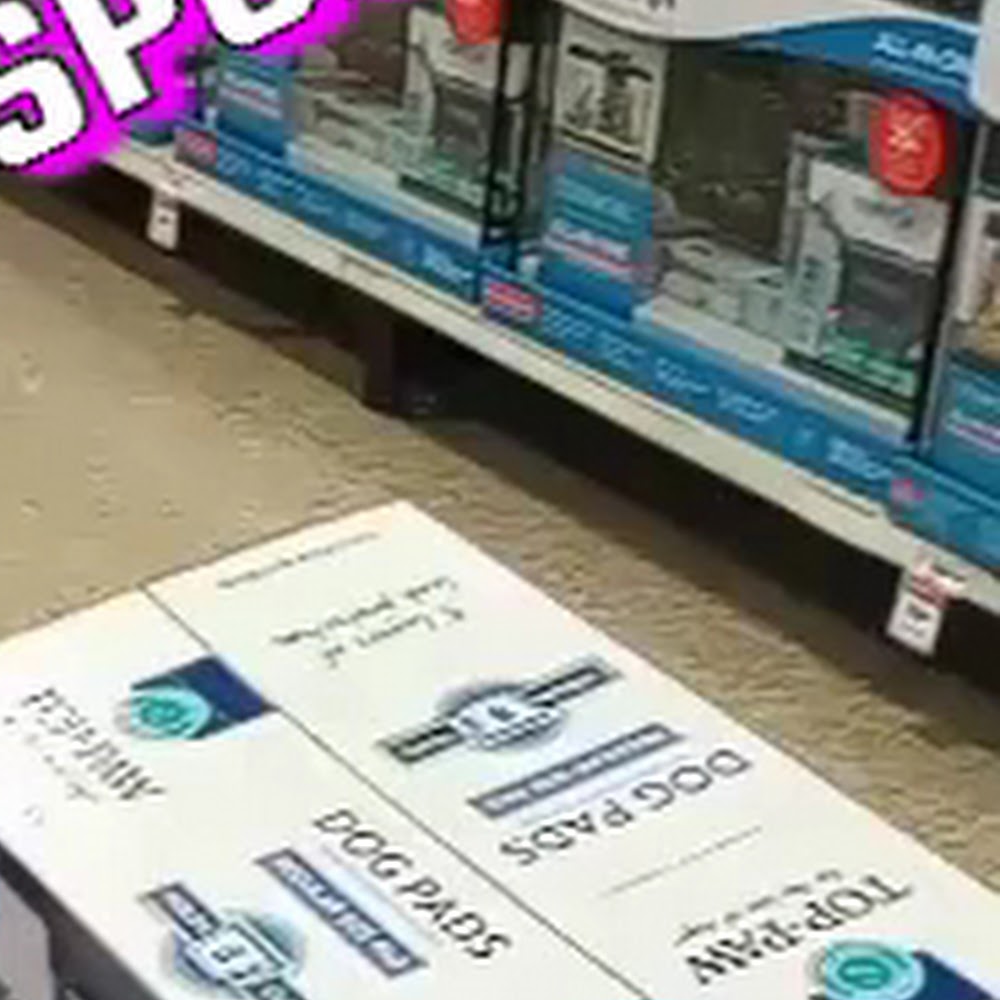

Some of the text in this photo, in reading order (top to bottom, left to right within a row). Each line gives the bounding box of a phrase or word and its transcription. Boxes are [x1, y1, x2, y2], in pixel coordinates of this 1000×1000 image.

[630, 748, 753, 812] DOG
[499, 798, 635, 867] PADS
[313, 808, 414, 881] DOG
[395, 874, 513, 960] PADS
